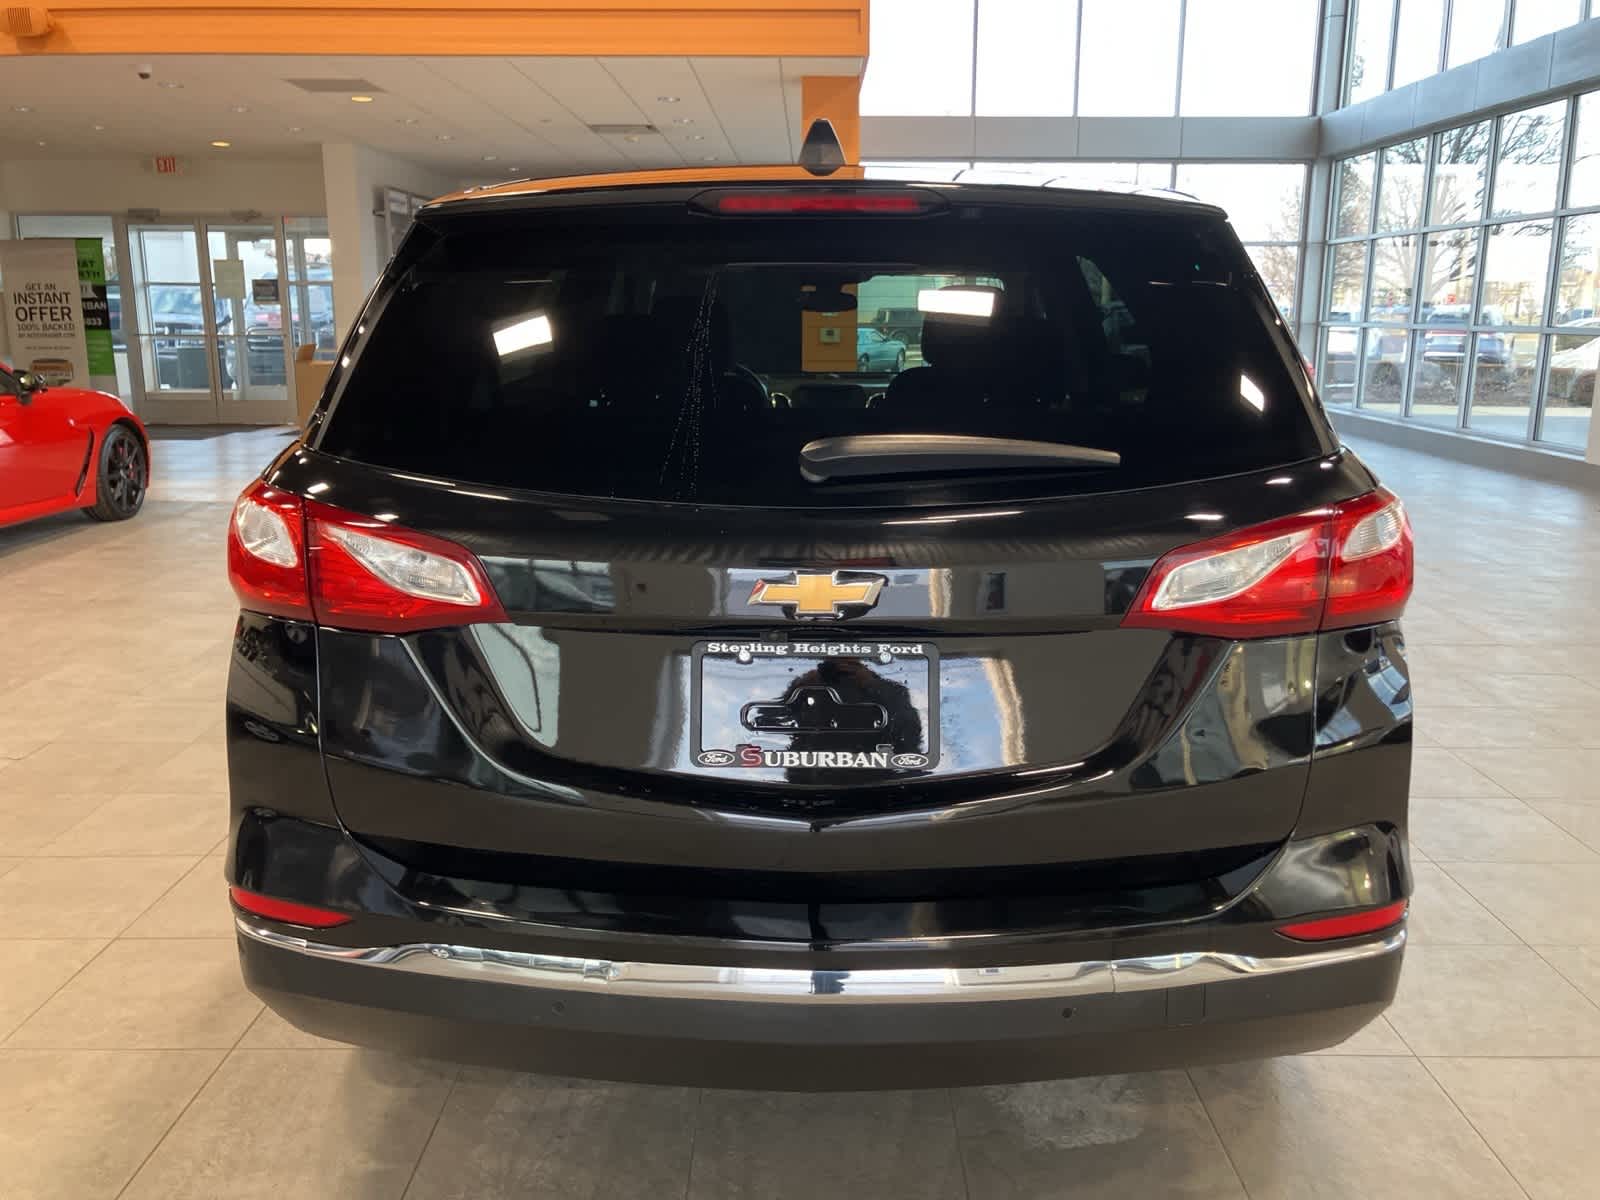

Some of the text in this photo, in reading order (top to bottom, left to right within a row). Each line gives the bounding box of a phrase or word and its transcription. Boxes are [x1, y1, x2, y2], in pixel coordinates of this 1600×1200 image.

[25, 282, 56, 291] GET AN
[13, 292, 71, 305] INSTANT
[15, 306, 72, 322] OFFER
[42, 323, 75, 331] BACKED
[707, 643, 924, 655] Sterling Heights Ford
[704, 752, 730, 765] Ford
[739, 746, 888, 768] SUBURBAN
[897, 754, 922, 767] Ford
